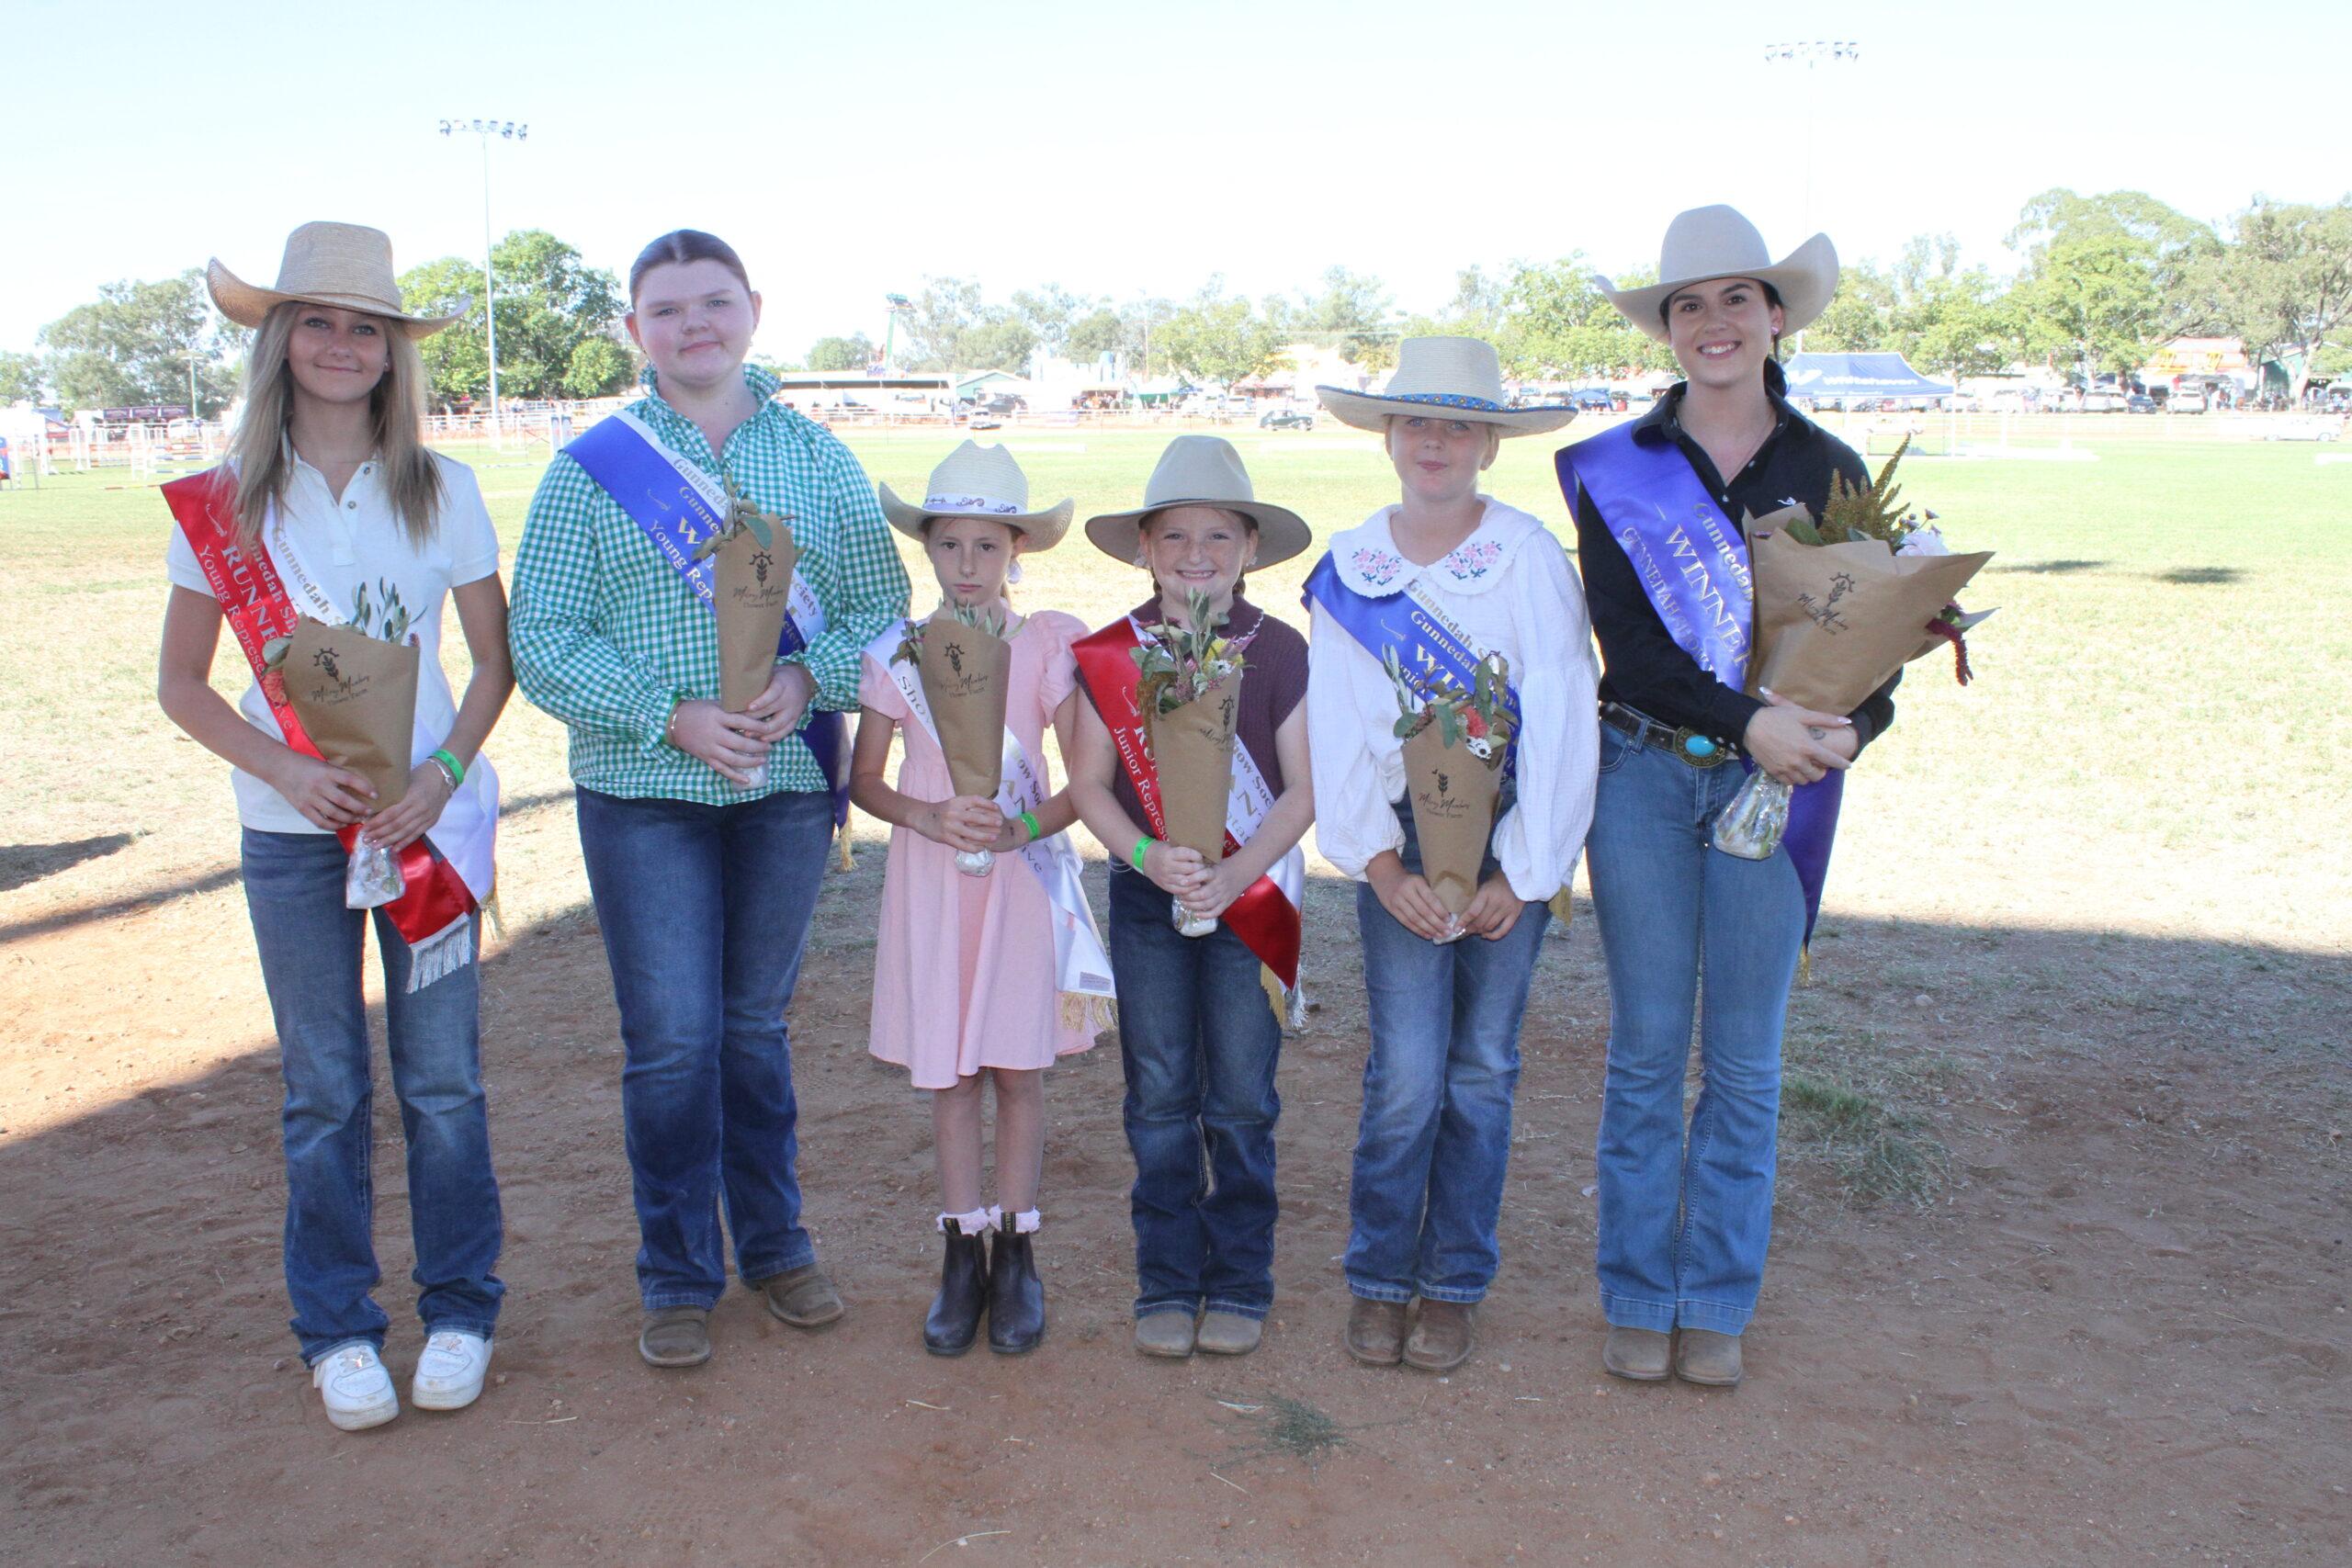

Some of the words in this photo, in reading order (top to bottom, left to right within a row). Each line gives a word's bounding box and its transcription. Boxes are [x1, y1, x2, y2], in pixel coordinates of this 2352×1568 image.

[198, 545, 231, 604] Young
[272, 526, 331, 615] Gunnedah
[649, 519, 687, 570] Young
[1623, 526, 1680, 617] GUNNEDAH
[1691, 502, 1755, 602] Gunnedah
[1407, 578, 1474, 649] Gunnedah
[1114, 727, 1143, 776] Junior
